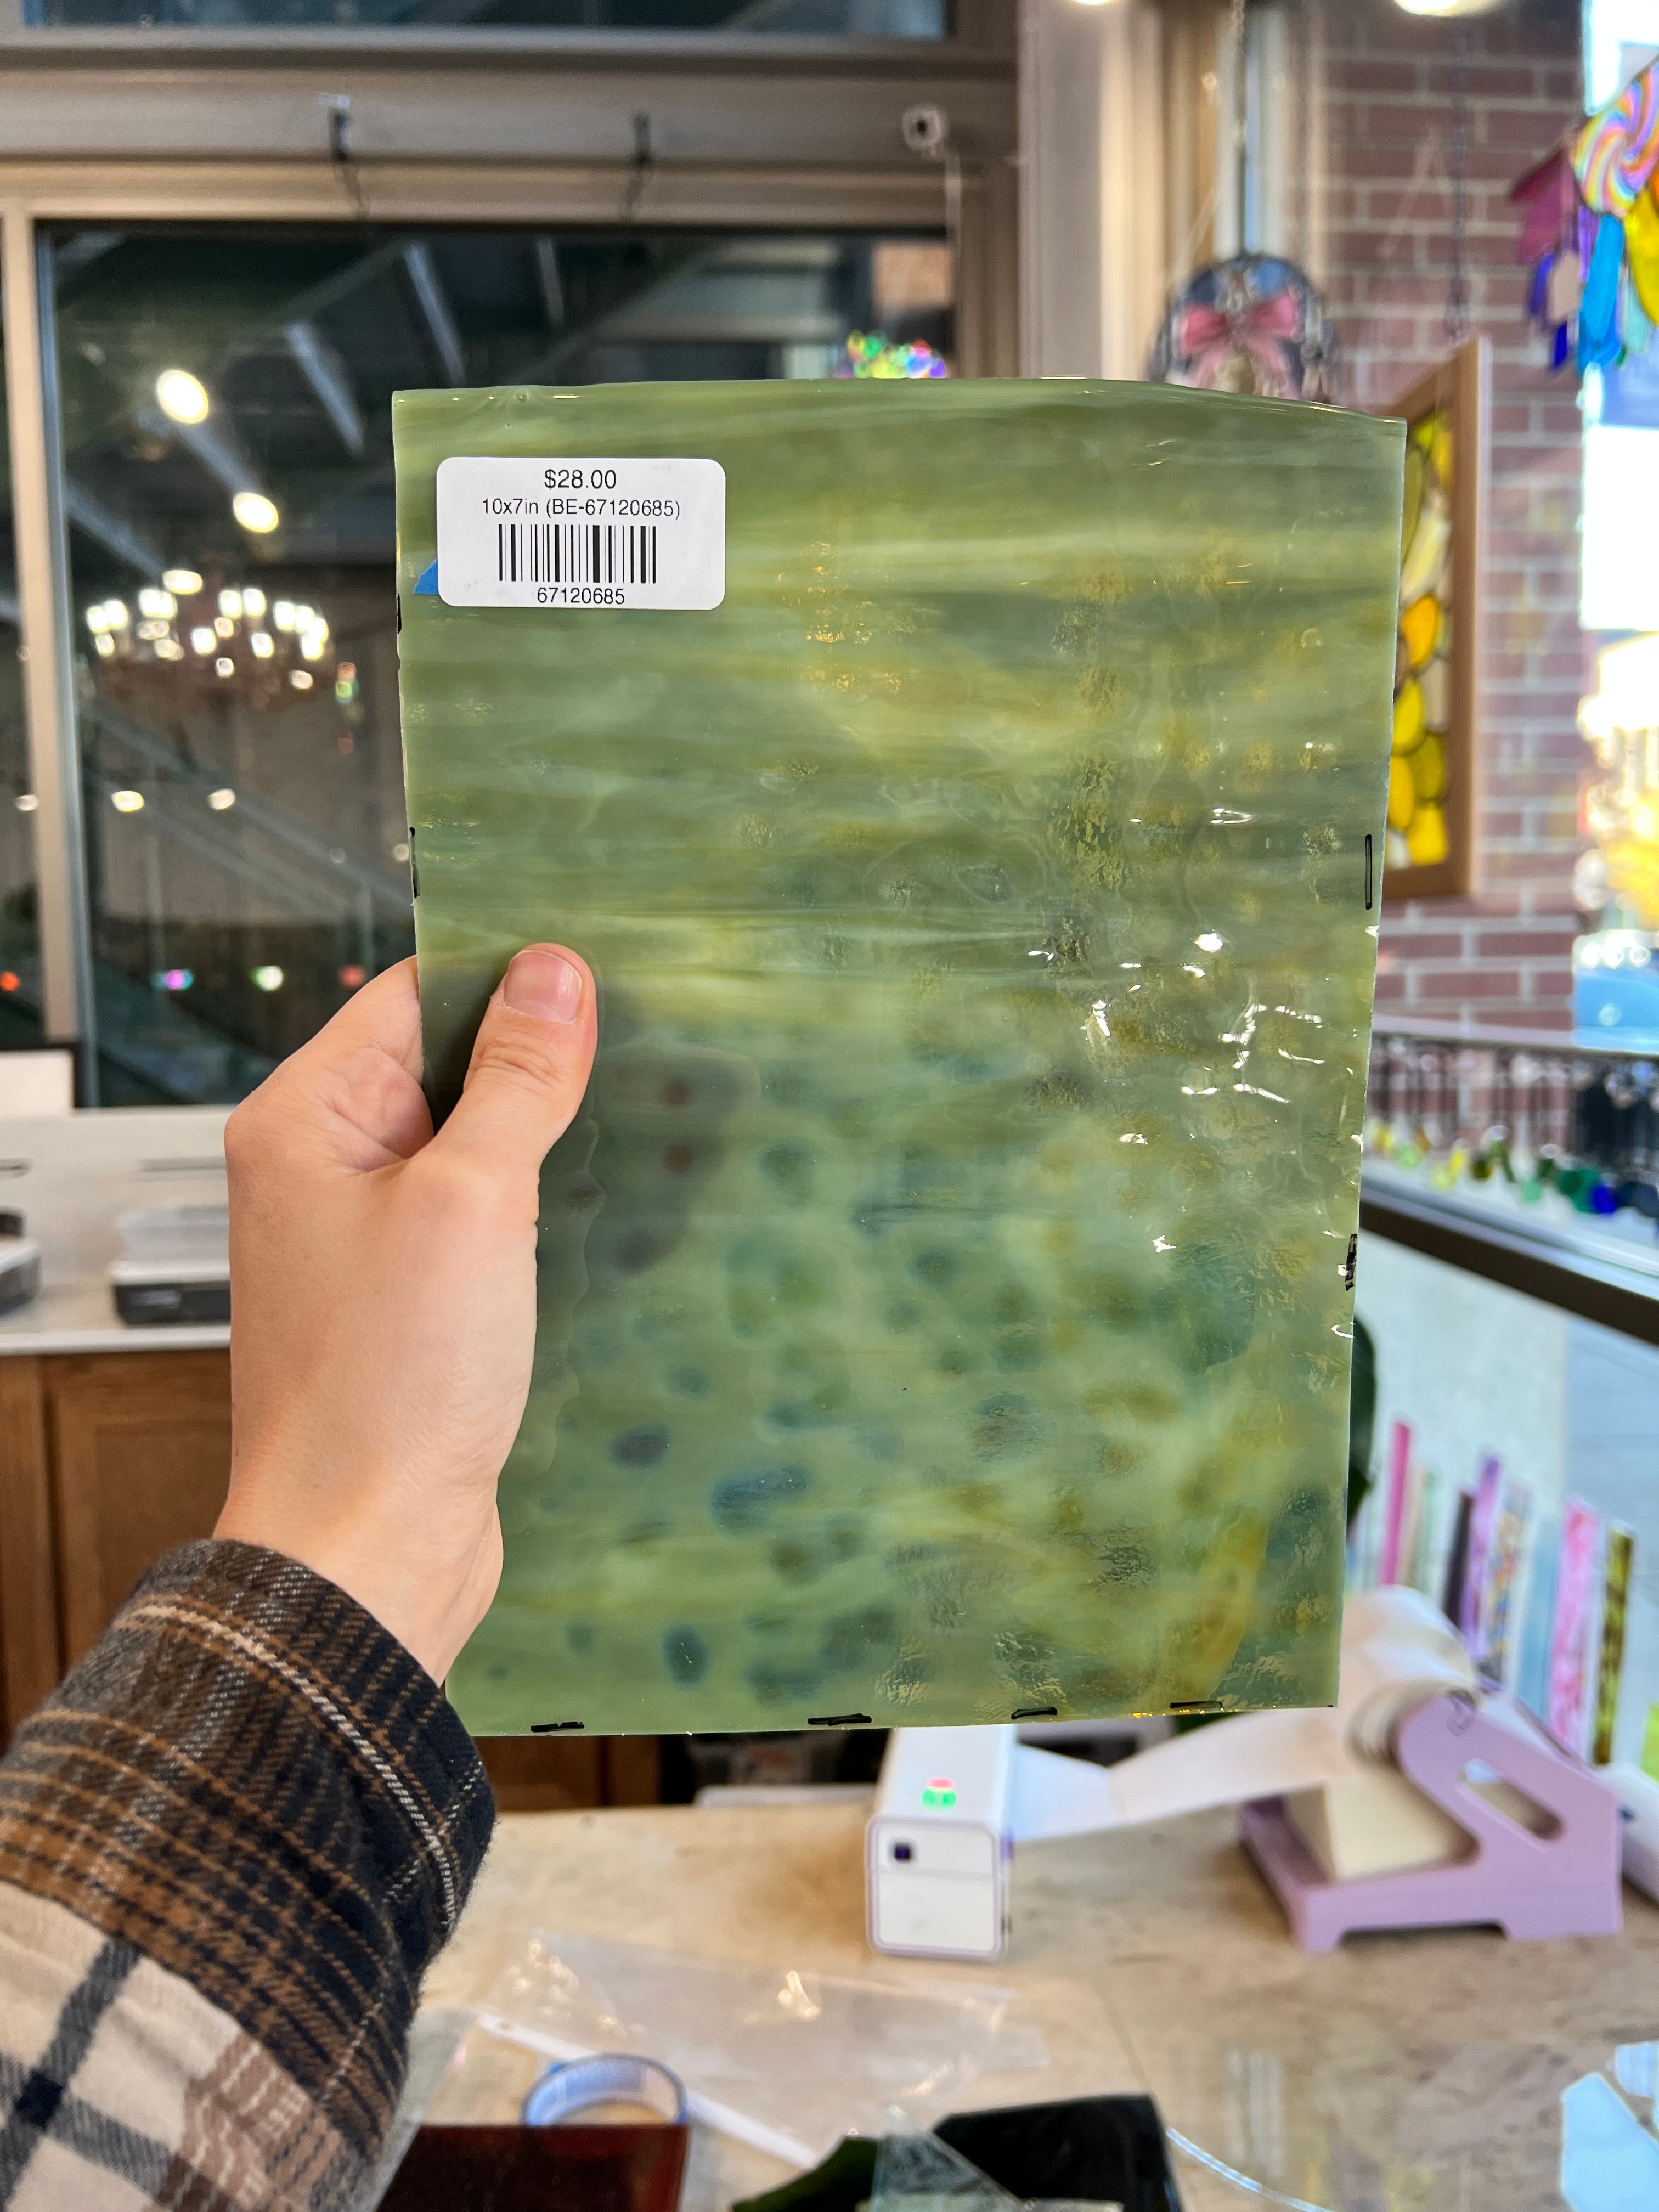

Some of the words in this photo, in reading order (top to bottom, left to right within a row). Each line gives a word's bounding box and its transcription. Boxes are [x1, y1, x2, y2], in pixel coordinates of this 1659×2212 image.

[544, 469, 617, 490] $28.00
[483, 498, 539, 515] 10x7in
[546, 499, 680, 520] (BE-67120685)
[537, 588, 625, 605] 67120685
